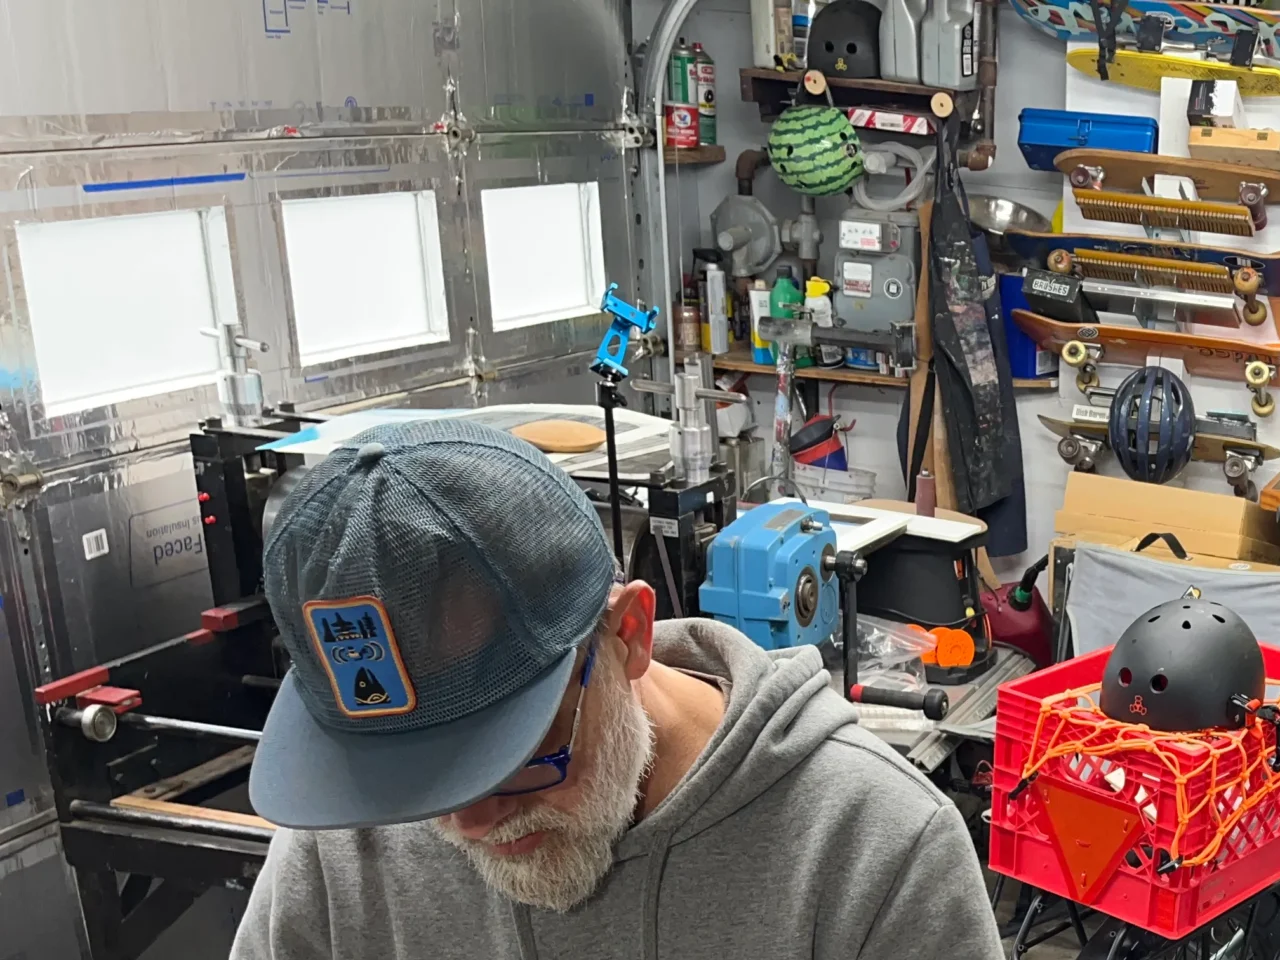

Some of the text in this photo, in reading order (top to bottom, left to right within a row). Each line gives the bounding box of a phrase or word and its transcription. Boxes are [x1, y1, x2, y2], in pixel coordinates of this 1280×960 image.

[1033, 279, 1070, 295] BRUSHES
[146, 519, 190, 538] Insulation
[153, 532, 203, 565] Faced
